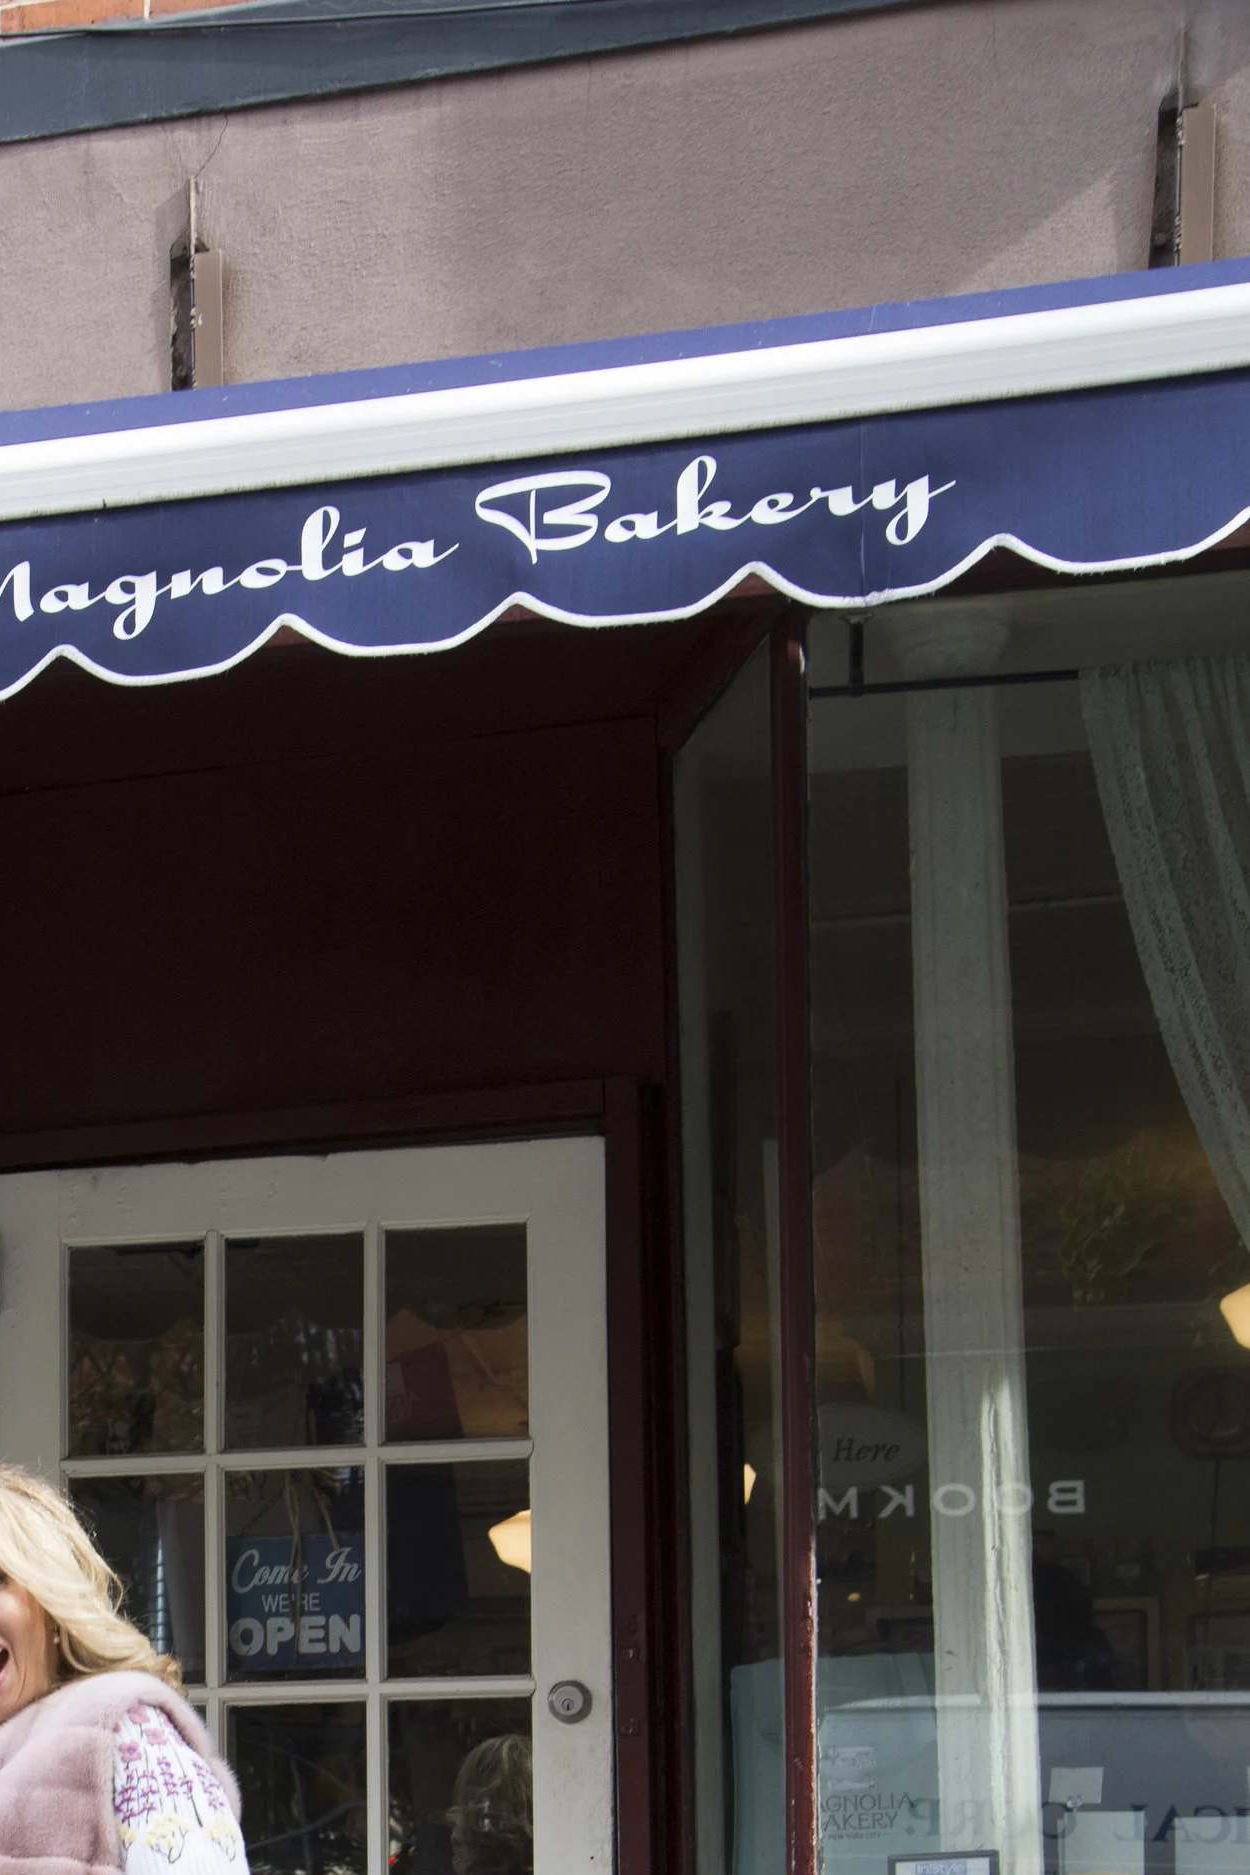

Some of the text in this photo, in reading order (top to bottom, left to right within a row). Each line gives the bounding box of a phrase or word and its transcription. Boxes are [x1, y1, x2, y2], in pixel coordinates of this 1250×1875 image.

[475, 454, 957, 565] Bakery
[831, 1437, 901, 1463] Here
[231, 1547, 362, 1594] Come In
[261, 1592, 321, 1613] WE'RE
[229, 1614, 361, 1657] OPEN
